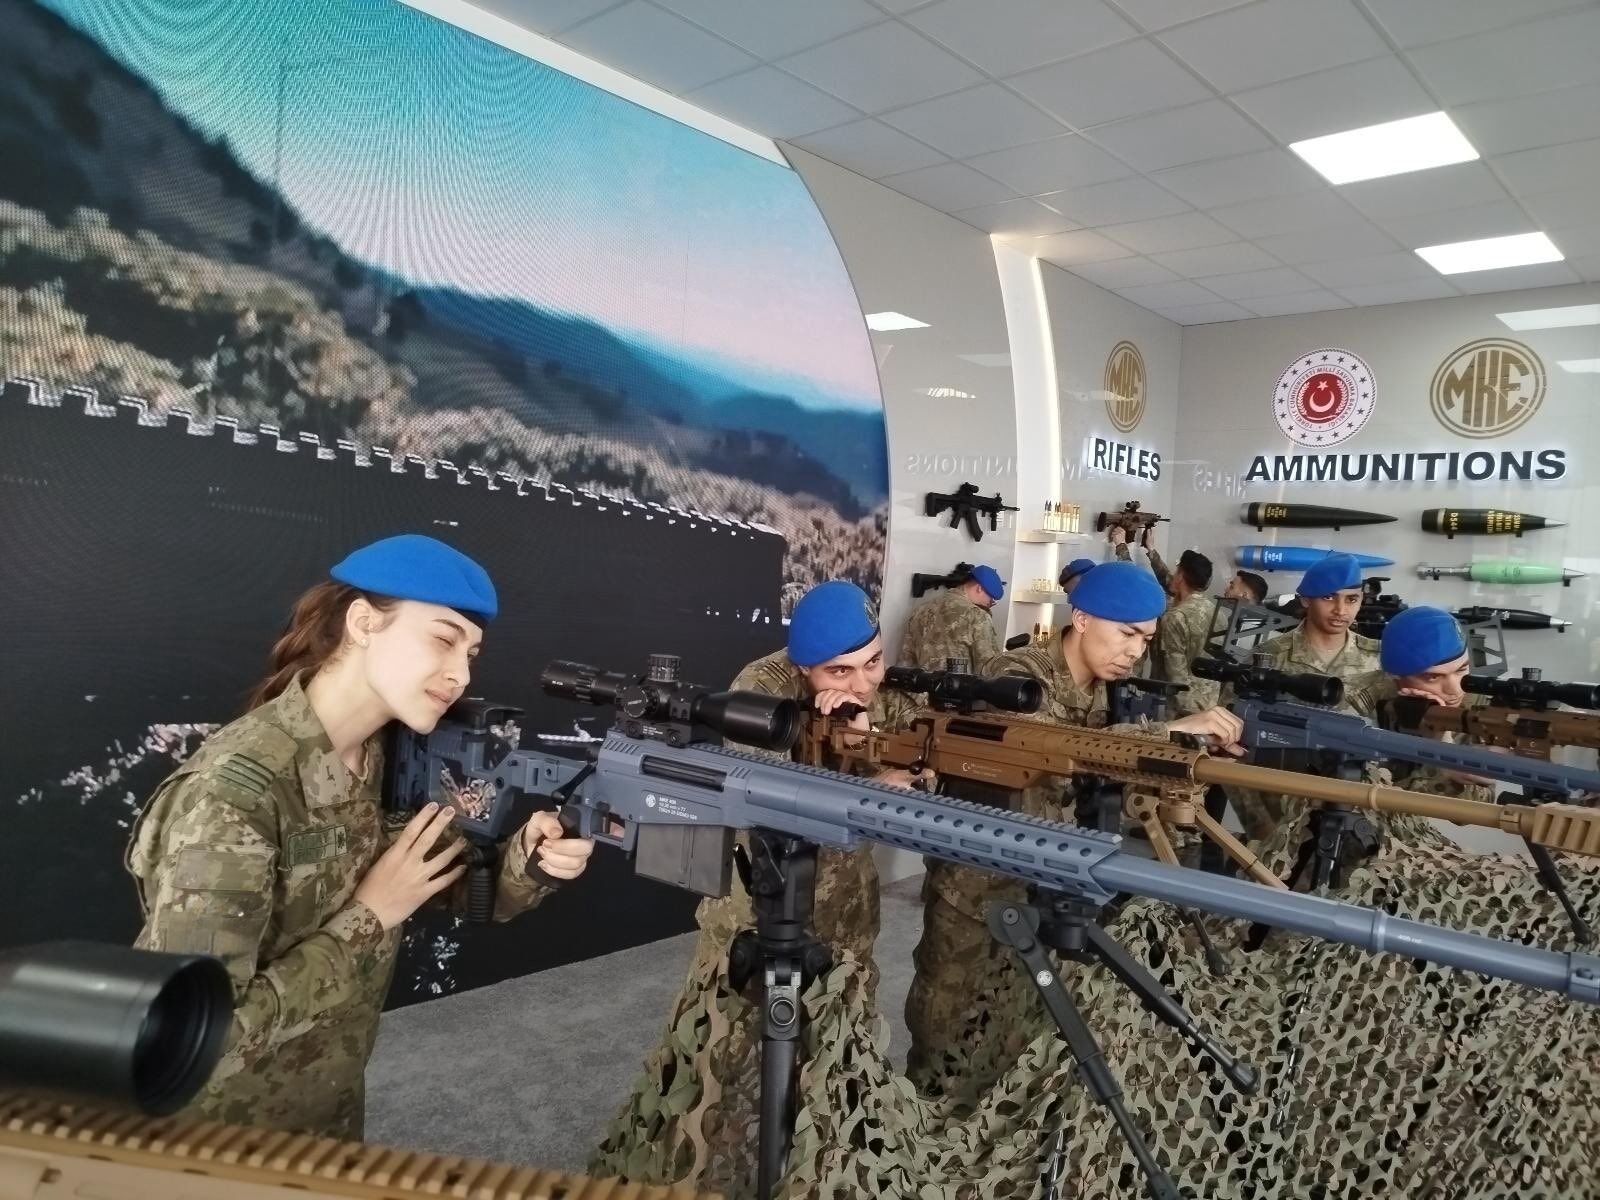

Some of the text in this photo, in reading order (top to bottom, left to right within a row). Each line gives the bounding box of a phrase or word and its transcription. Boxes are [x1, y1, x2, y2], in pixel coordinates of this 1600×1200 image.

[1443, 349, 1530, 428] MKE
[1093, 437, 1162, 482] RIFLES
[1245, 449, 1567, 482] AMMUNITIONS
